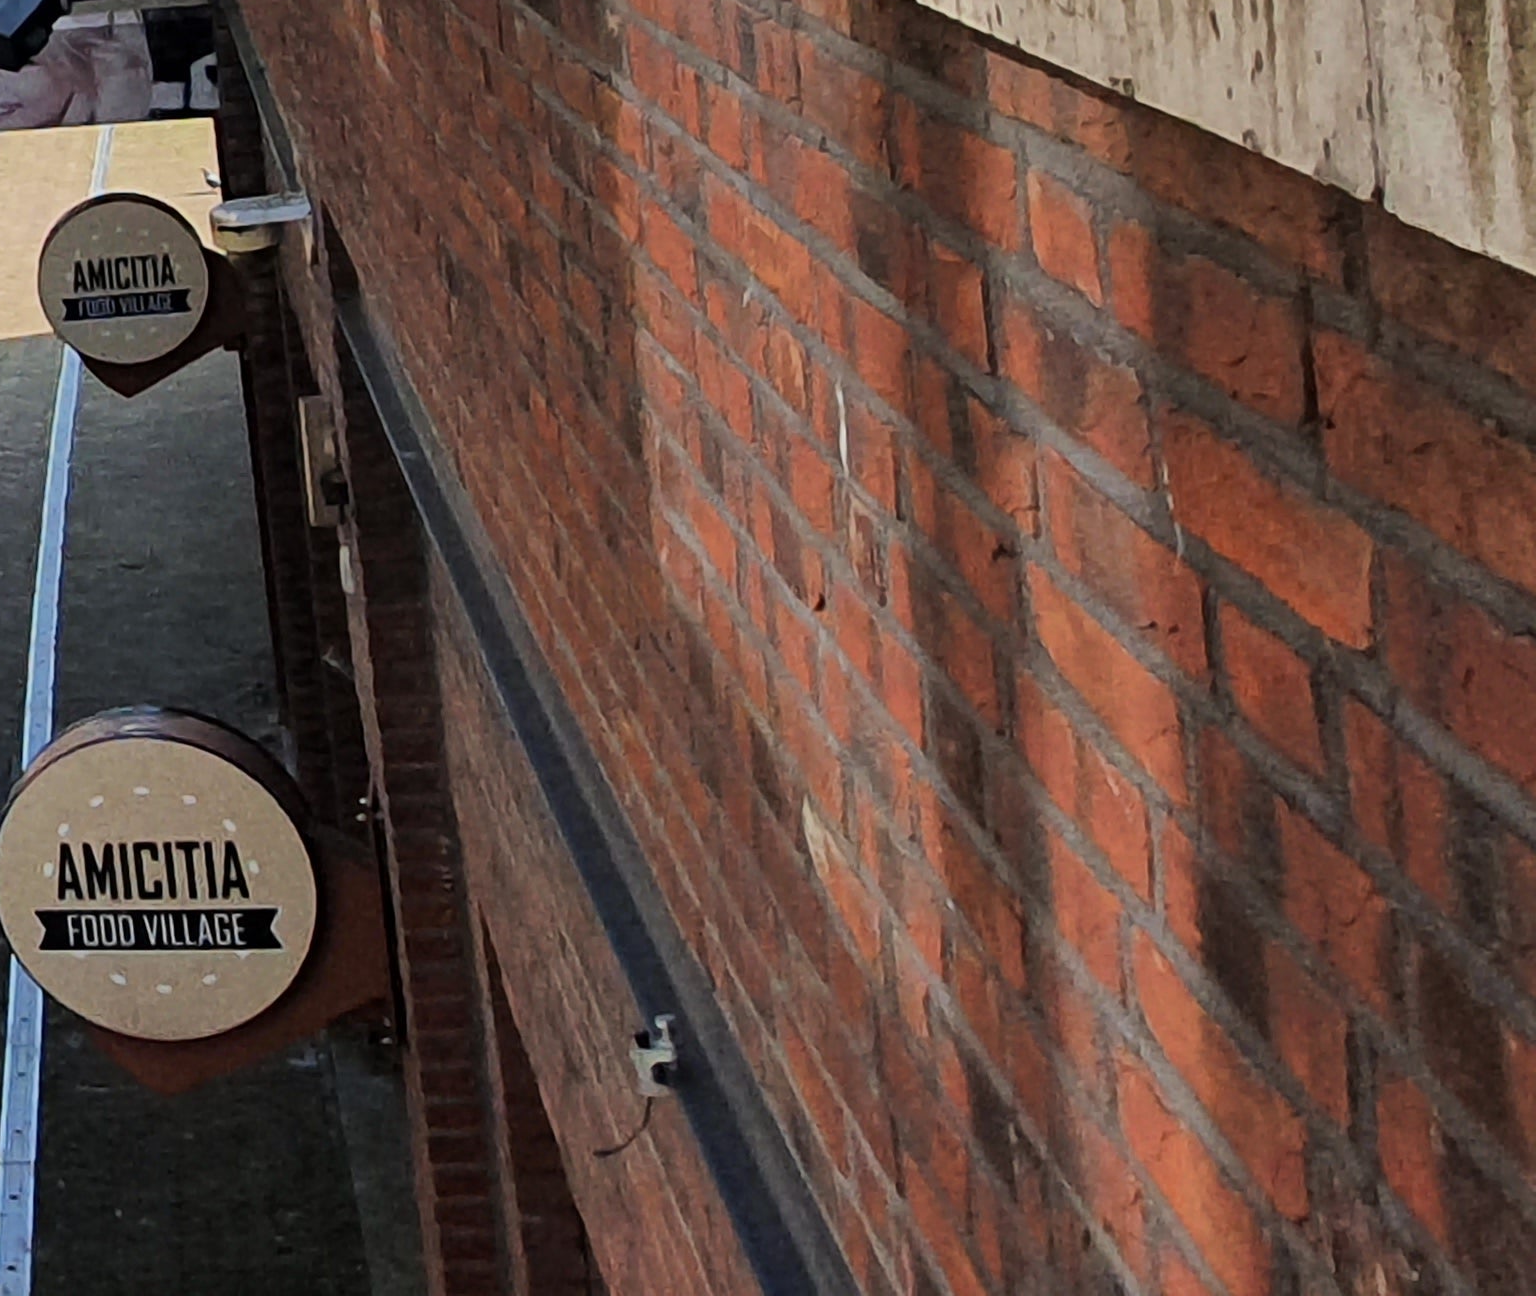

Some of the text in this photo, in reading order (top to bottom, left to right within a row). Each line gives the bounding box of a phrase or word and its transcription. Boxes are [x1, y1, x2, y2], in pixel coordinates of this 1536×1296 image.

[72, 253, 177, 294] AMICITIA
[57, 840, 250, 901] AMICITIA
[66, 912, 248, 947] FOOD VILLAGE
